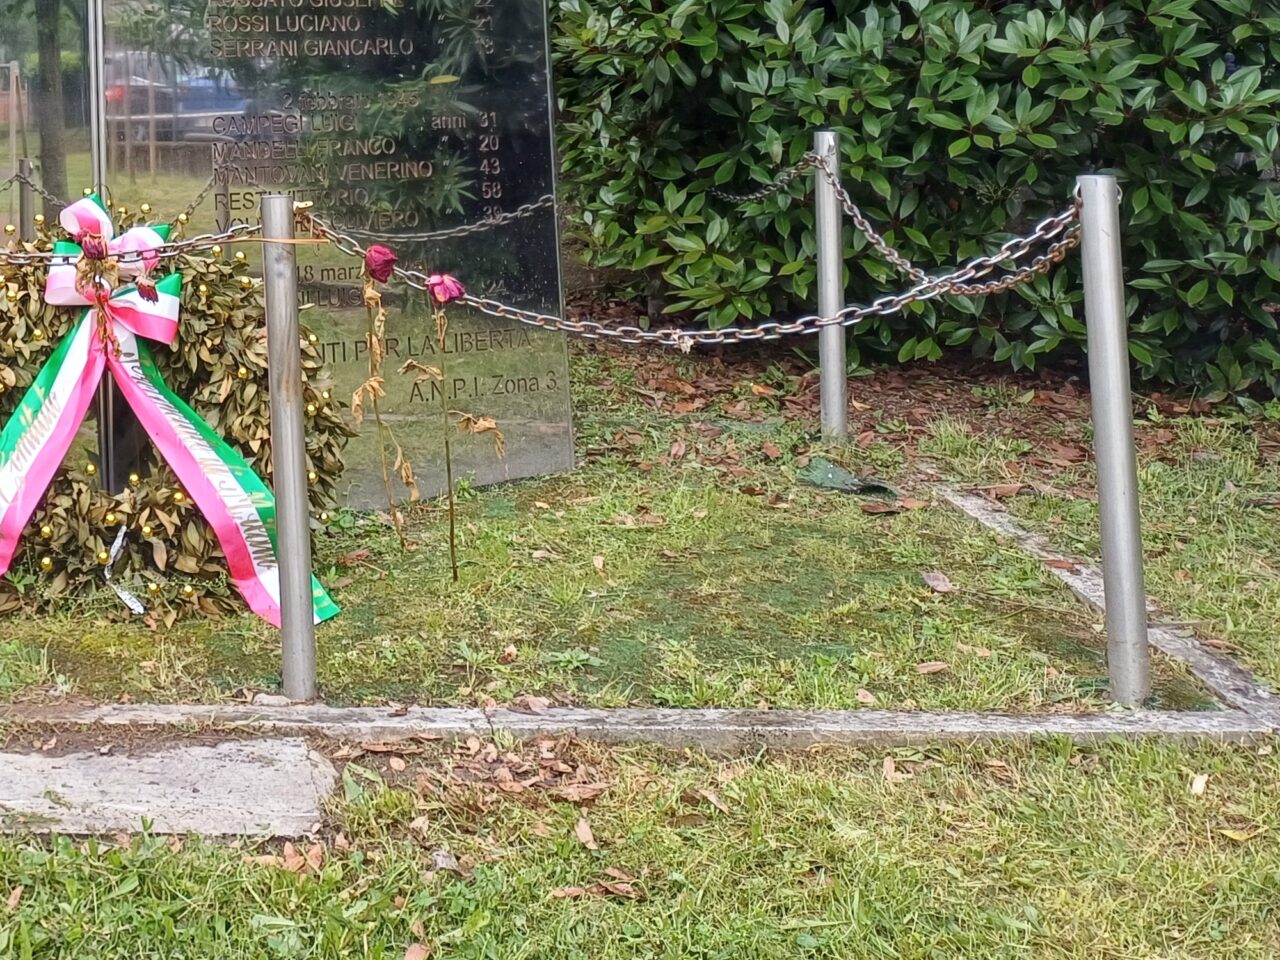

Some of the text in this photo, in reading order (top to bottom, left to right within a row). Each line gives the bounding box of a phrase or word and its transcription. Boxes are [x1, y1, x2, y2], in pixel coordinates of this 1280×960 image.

[207, 14, 270, 32] ROSSI
[275, 14, 362, 33] LUCIANO
[208, 38, 298, 58] SERRANI
[303, 38, 414, 57] GIANCARLO
[298, 90, 371, 111] febbraio
[212, 111, 498, 135] CAMPEGI LUIGI anni 31
[211, 134, 500, 162] MANDELLI FRANCO 20
[213, 158, 500, 186] MANTOVANI VENERINO 43
[214, 190, 273, 211] RES
[278, 187, 370, 210] ITTORIO
[320, 265, 366, 281] marz
[354, 337, 401, 361] PR
[407, 335, 436, 357] LA
[491, 374, 540, 395] Zona
